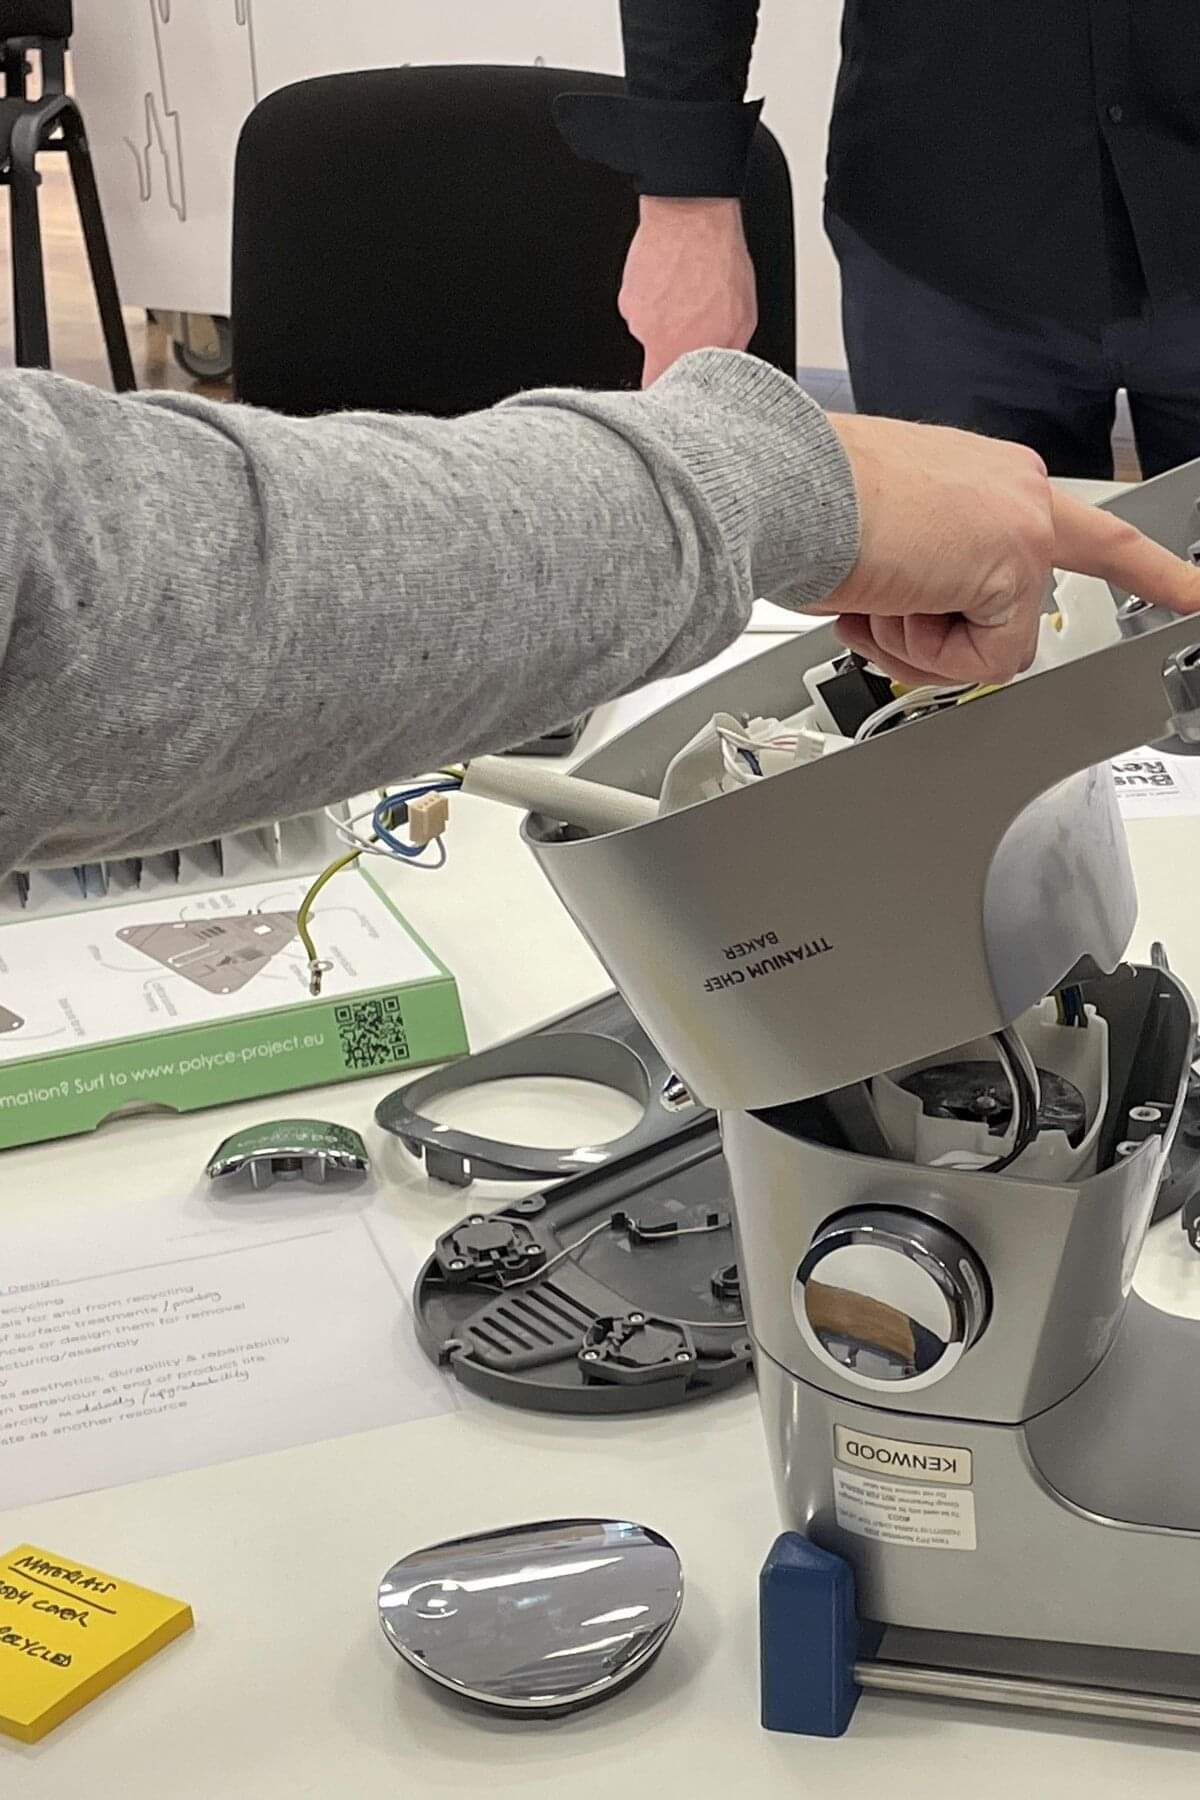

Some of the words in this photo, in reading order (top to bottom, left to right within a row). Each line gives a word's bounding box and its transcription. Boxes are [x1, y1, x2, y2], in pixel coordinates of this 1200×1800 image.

[721, 931, 779, 960] BAKER
[746, 937, 833, 978] TITANIUM
[703, 970, 745, 992] CHEF
[74, 1073, 105, 1094] Surf
[109, 1072, 128, 1086] to
[131, 1032, 325, 1082] www.polyce-project.eu
[53, 1307, 81, 1319] and
[86, 1299, 121, 1312] from
[126, 1286, 194, 1304] recycling
[75, 1308, 159, 1329] treatments
[60, 1330, 112, 1345] design
[115, 1320, 155, 1334] them
[159, 1315, 181, 1325] for
[185, 1302, 247, 1321] removal
[108, 1357, 182, 1379] durability
[201, 1336, 291, 1358] repairability
[18, 1390, 97, 1412] behaviour
[122, 1378, 152, 1391] end
[53, 1416, 113, 1435] another
[119, 1401, 188, 1421] resource
[846, 1441, 957, 1473] KENWOOD
[13, 1555, 117, 1593] MATERIALS
[0, 1580, 34, 1605] ODY
